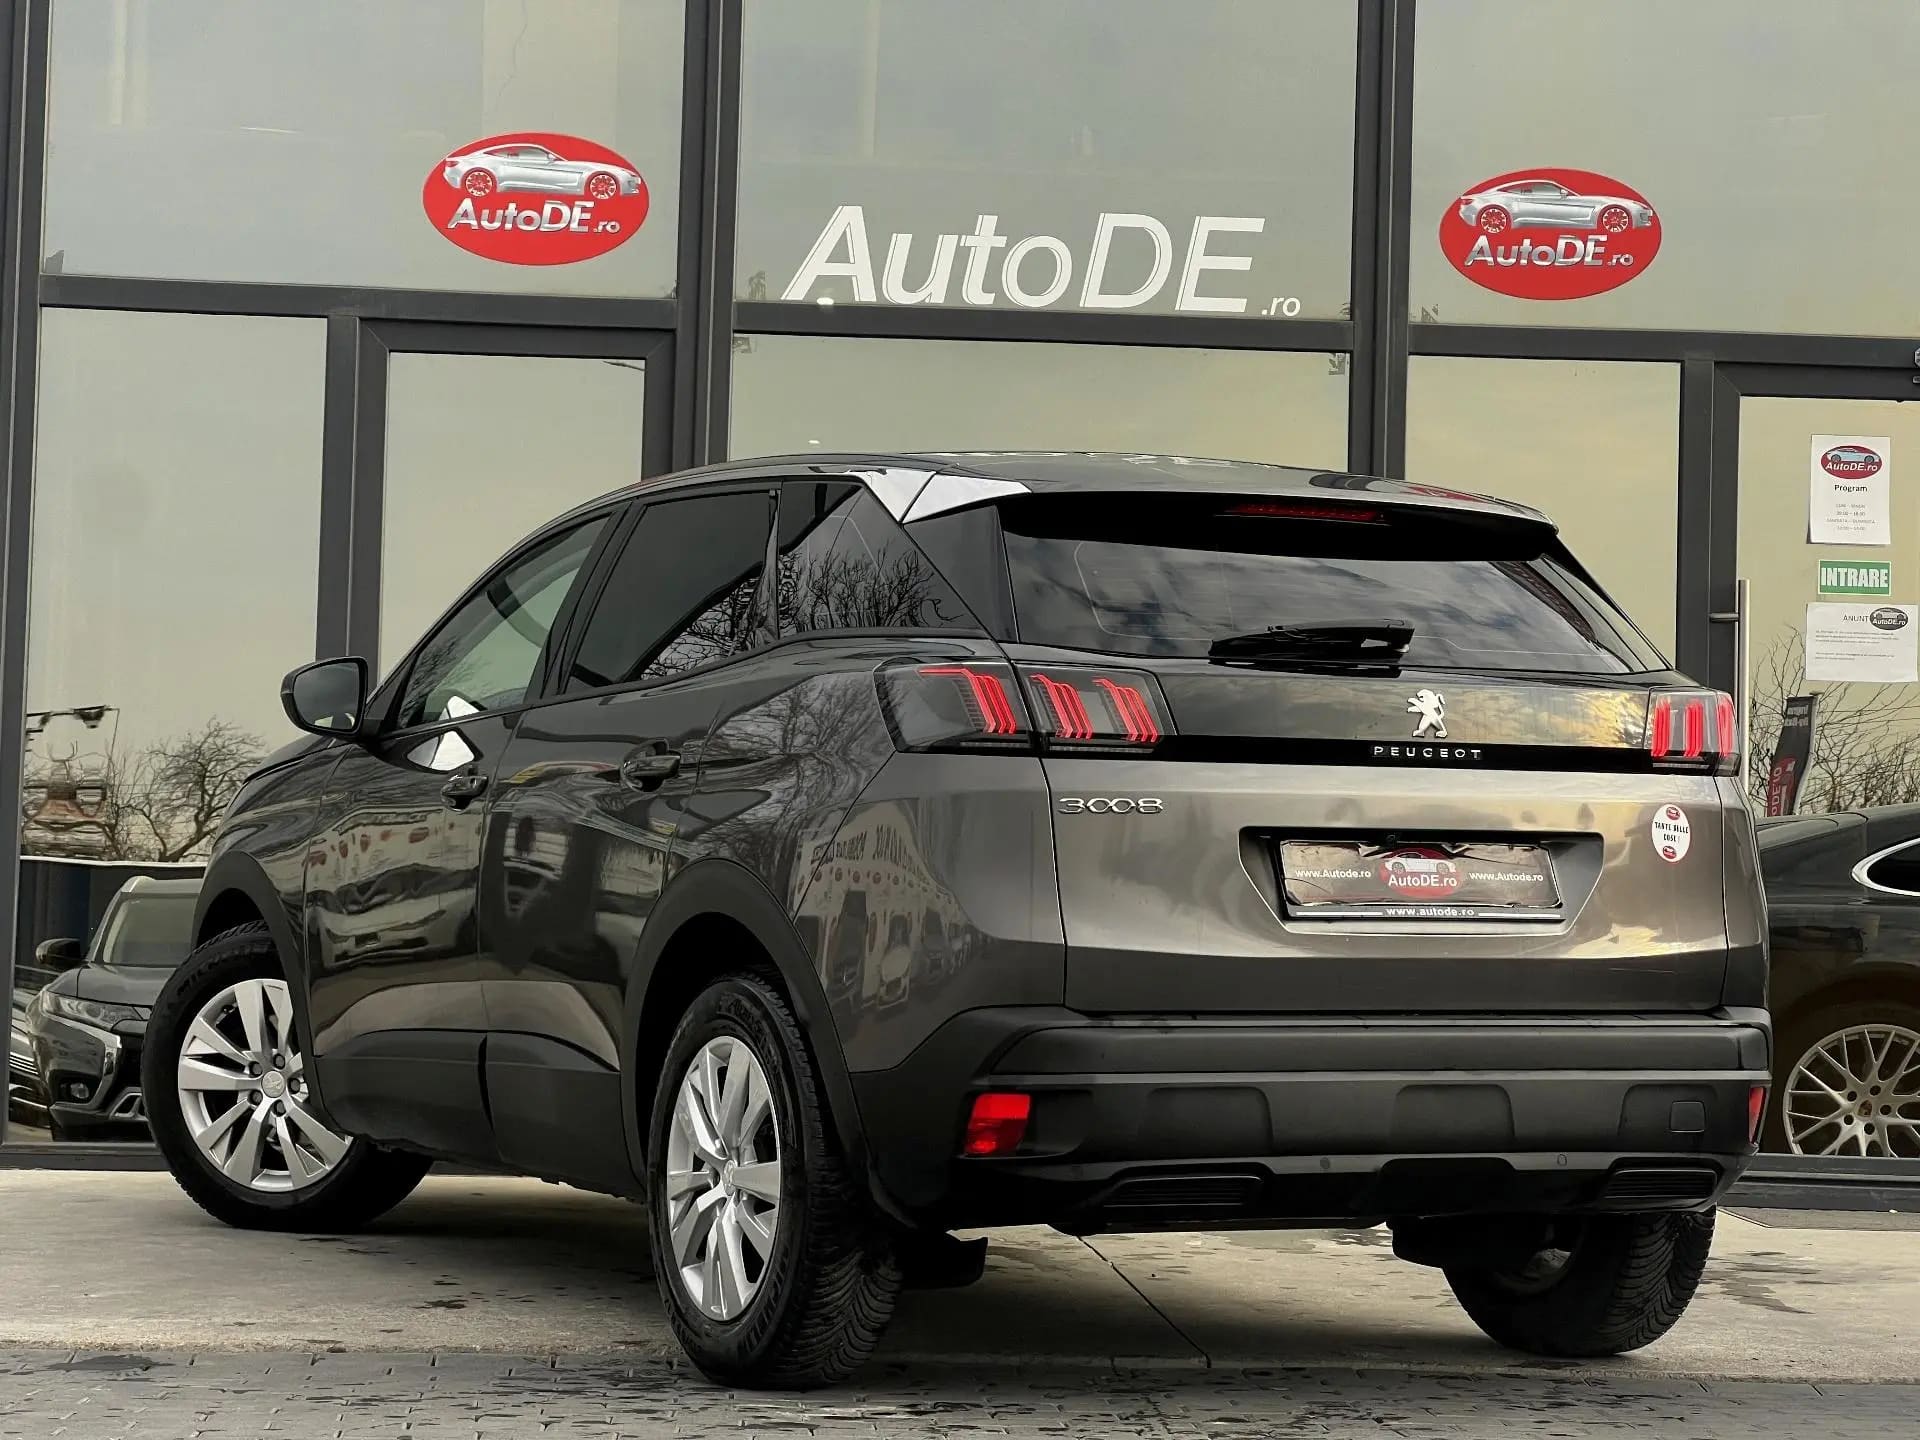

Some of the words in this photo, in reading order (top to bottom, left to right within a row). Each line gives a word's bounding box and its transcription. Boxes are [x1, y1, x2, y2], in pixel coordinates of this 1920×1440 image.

[1826, 462, 1878, 472] AutoDE.ro
[1834, 484, 1868, 493] Program
[1821, 568, 1888, 587] INTRARE
[1373, 746, 1482, 759] PEUGEOT
[1057, 798, 1164, 814] 3008
[1295, 868, 1372, 878] www.Autode.ro
[1469, 871, 1544, 882] www.Autode.ro
[1388, 874, 1458, 887] AutoDE.ro
[1386, 907, 1475, 917] www.autode.ro
